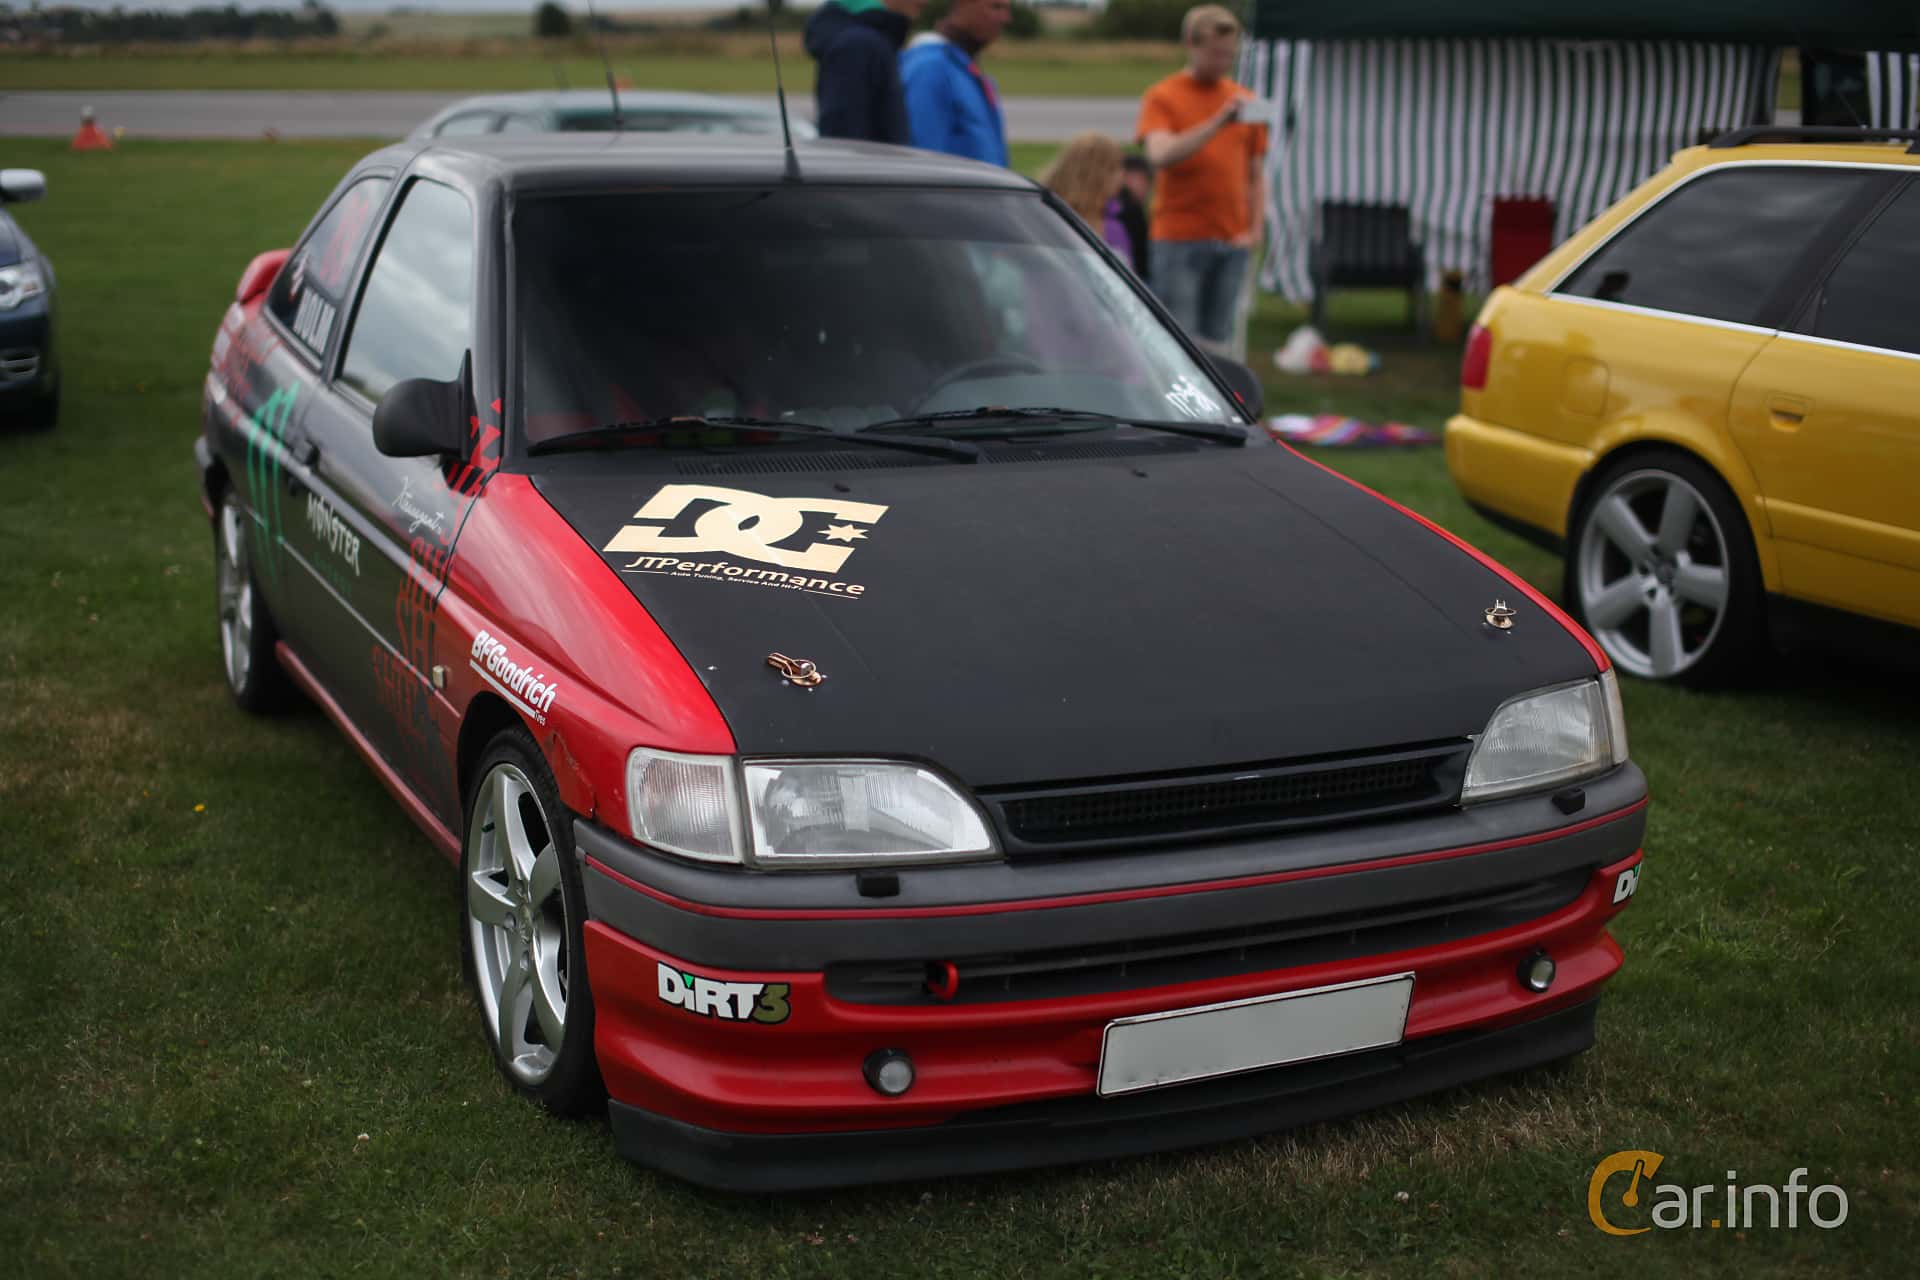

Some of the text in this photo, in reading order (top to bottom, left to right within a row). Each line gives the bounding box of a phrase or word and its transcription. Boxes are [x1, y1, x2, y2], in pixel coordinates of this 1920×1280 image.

[307, 491, 361, 577] MONSTER
[624, 556, 865, 595] JTPerformance
[471, 629, 558, 713] BFGoodrich
